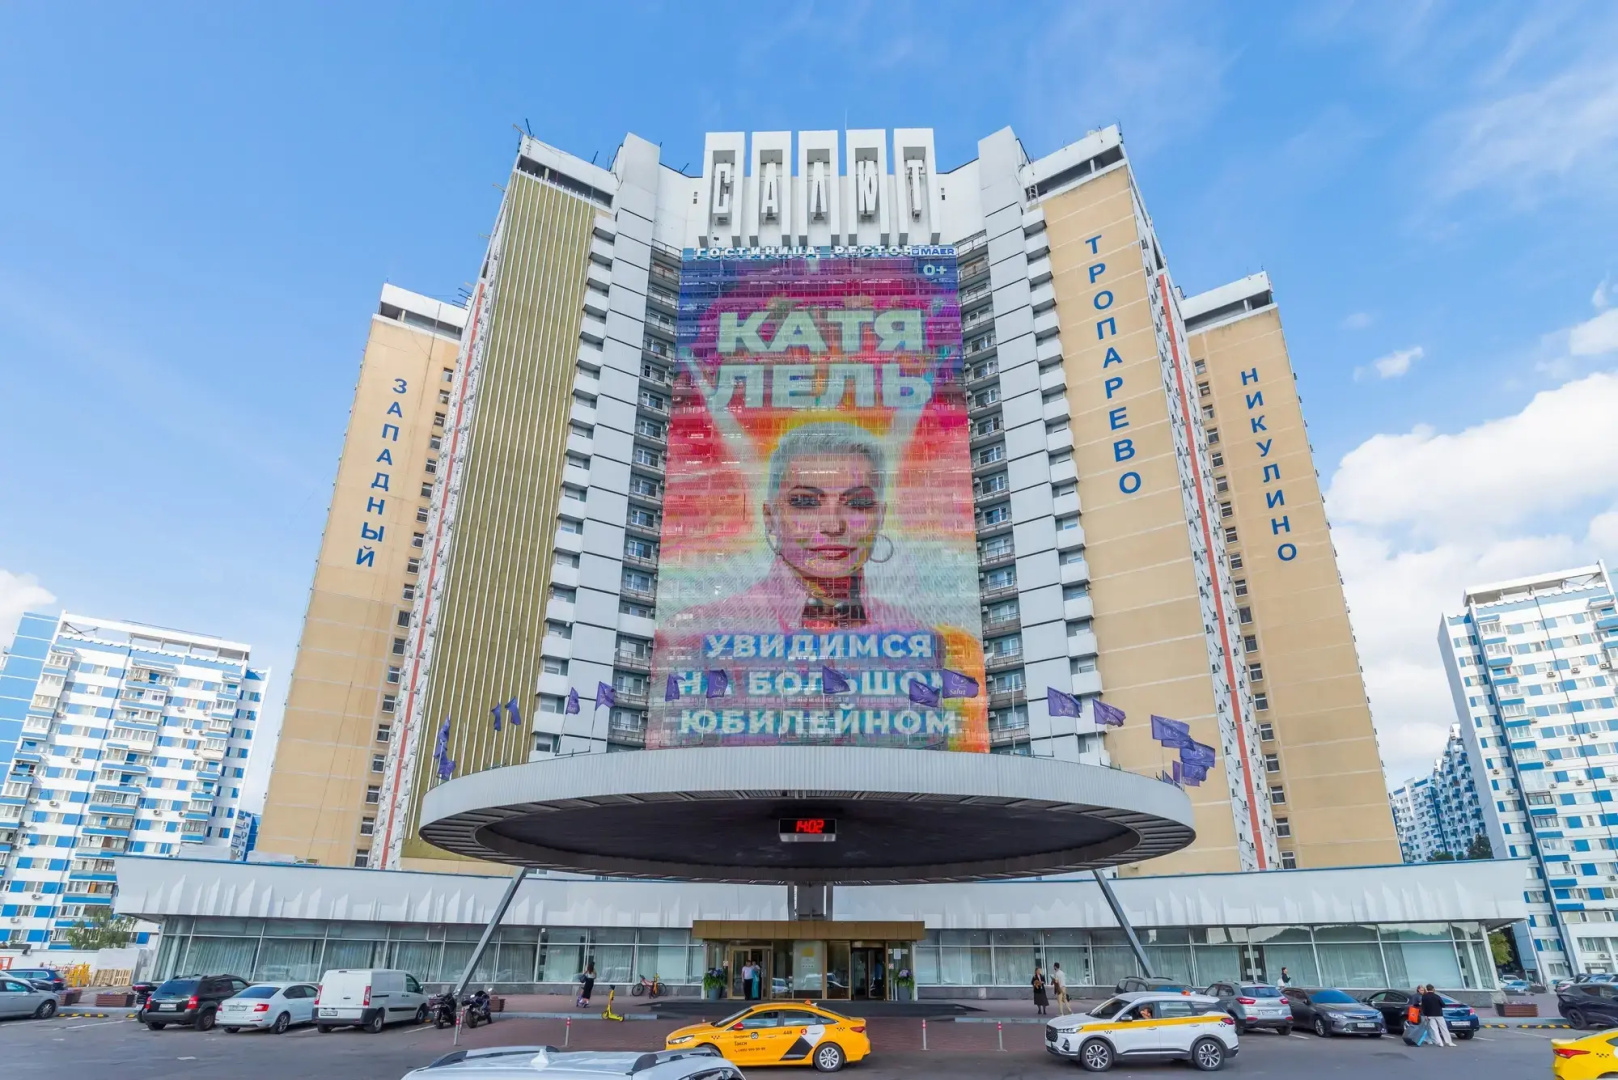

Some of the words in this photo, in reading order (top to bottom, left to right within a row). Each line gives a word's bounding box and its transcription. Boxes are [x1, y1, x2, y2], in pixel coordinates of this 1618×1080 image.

[712, 159, 925, 217] САЛЮТ
[696, 246, 816, 257] ГОСТИНИЦА
[834, 245, 940, 256] РЕСТОР
[923, 263, 947, 276] 0+
[718, 309, 923, 353] КАТЯ
[713, 363, 934, 408] ЛЕЛЬ
[1085, 235, 1142, 494] ТРОПАРЕВО
[356, 378, 408, 567] ЗАПАДНЫЙ
[1241, 367, 1297, 562] НИКУЛИНО
[706, 634, 932, 661] УВИДИМСЯ
[681, 703, 957, 735] ЮБИЛЕЙНОМ
